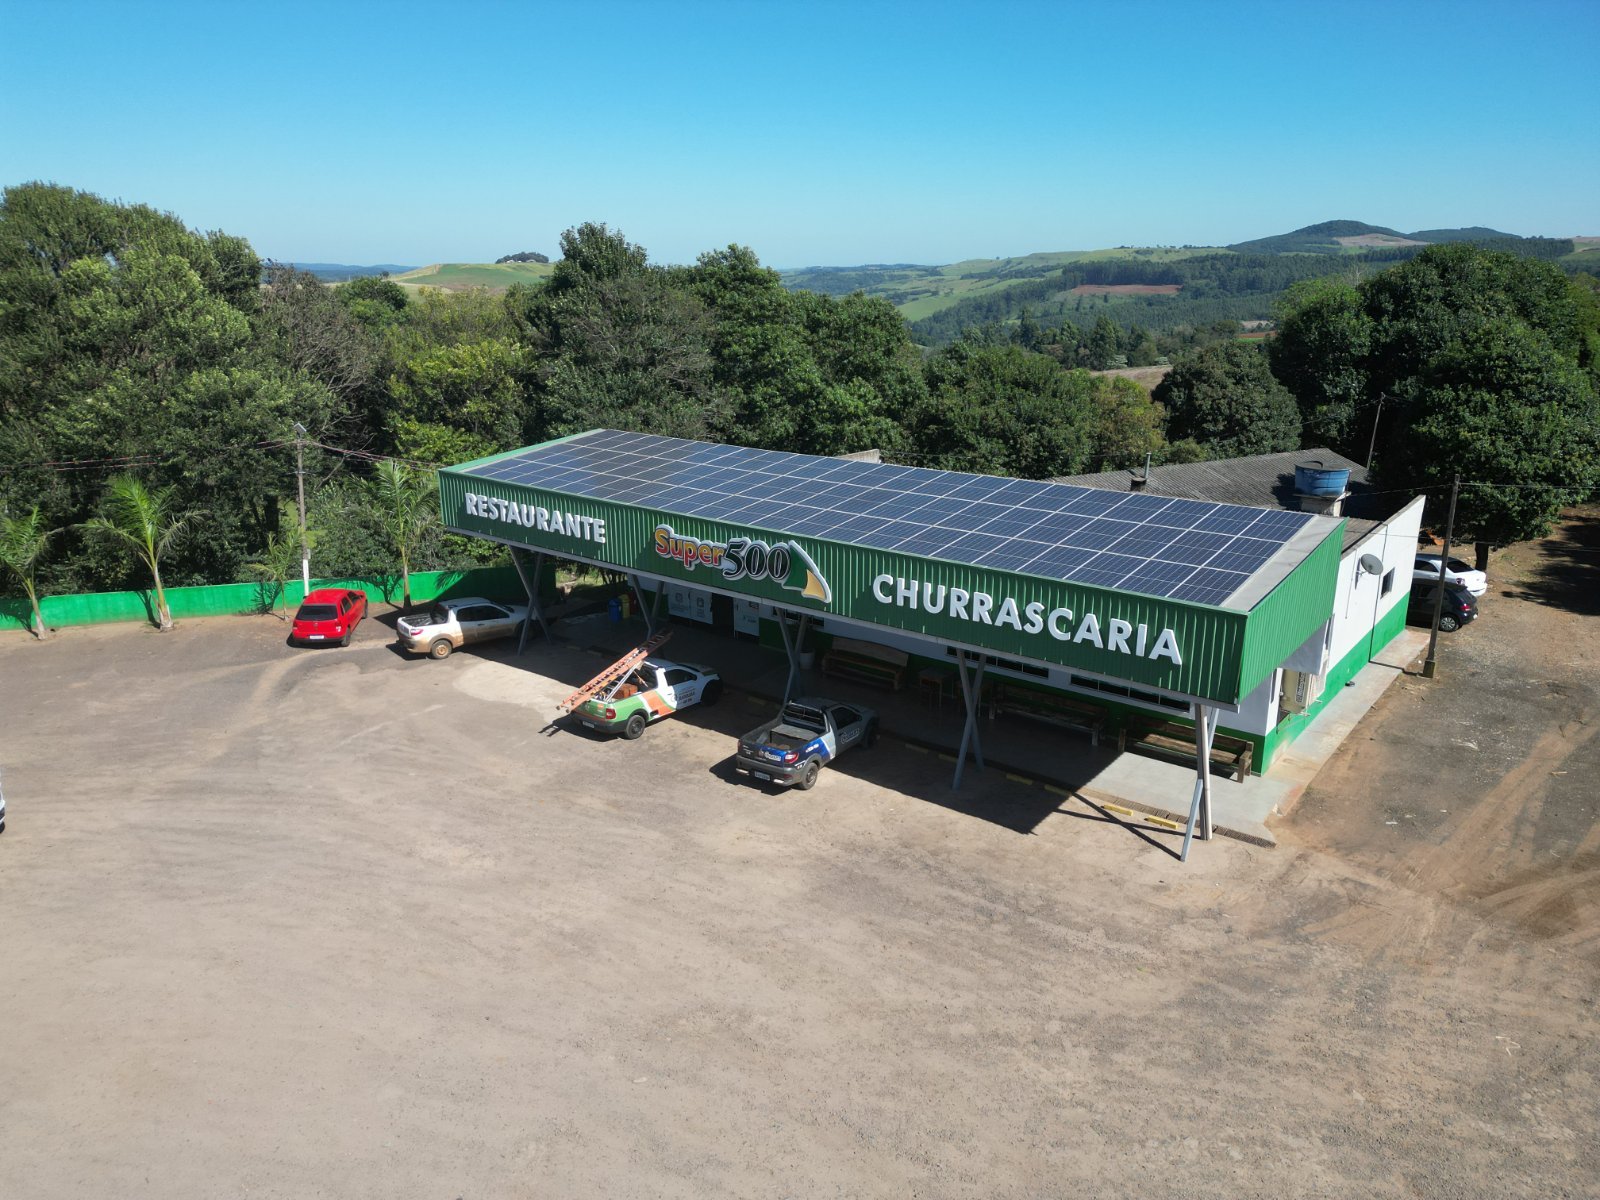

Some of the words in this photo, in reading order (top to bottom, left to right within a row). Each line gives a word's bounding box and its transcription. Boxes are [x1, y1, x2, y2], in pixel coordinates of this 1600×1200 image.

[464, 492, 606, 543] RESTAURANTE
[654, 526, 724, 569] Super
[722, 538, 792, 581] 500
[872, 574, 1182, 666] CHURRASCARIA
